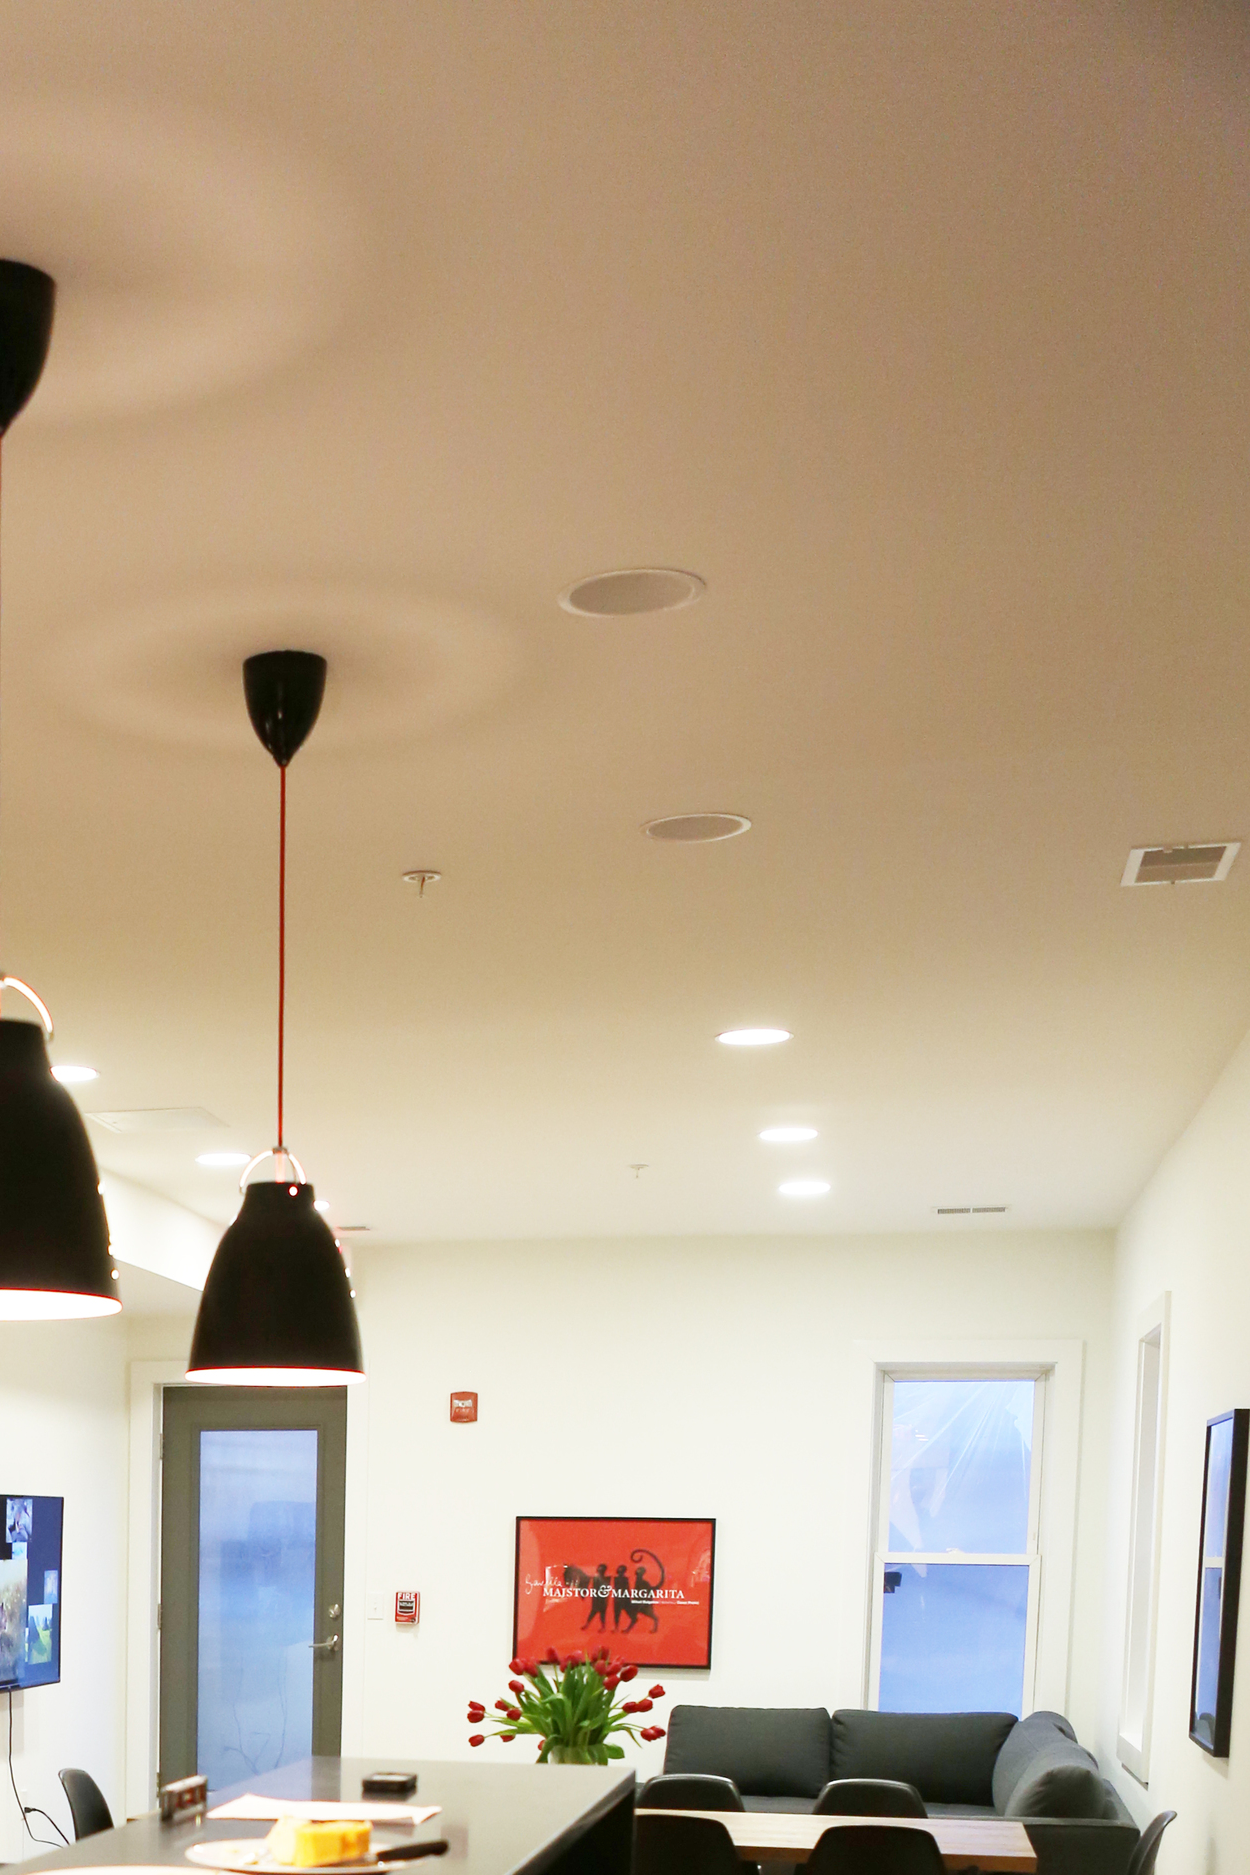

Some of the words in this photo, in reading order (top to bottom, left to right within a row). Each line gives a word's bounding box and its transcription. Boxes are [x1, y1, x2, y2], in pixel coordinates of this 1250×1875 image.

[397, 1592, 415, 1600] FIRE
[543, 1588, 598, 1599] MAJSTOR
[611, 1589, 685, 1599] MARGARITA
